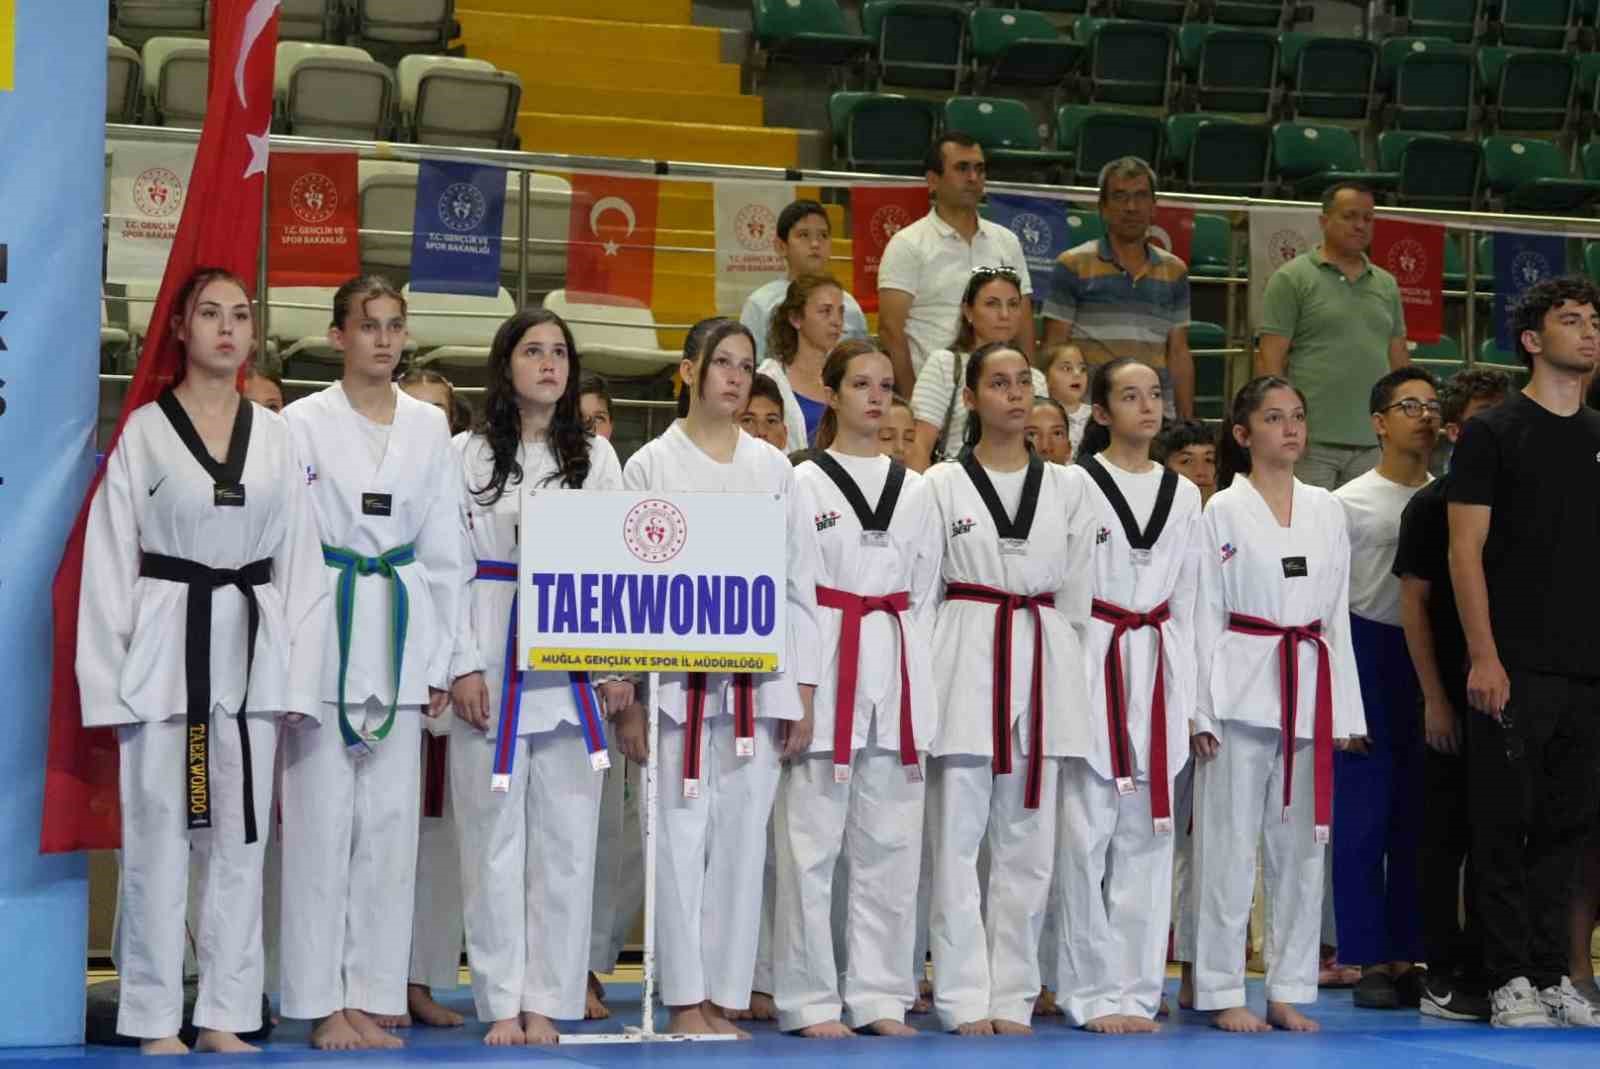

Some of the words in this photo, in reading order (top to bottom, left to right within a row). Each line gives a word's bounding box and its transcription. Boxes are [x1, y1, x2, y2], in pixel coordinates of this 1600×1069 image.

[121, 231, 144, 239] SPOR
[281, 235, 303, 244] SPOR
[425, 241, 446, 250] SPOR
[532, 573, 776, 636] TAEKWONDO
[542, 652, 581, 665] MUĞLA
[584, 655, 631, 667] GENÇLİK
[634, 656, 648, 666] VE
[650, 656, 679, 667] SPOR
[681, 655, 690, 667] İL
[693, 656, 765, 669] MÜDÜRLÜĞÜ
